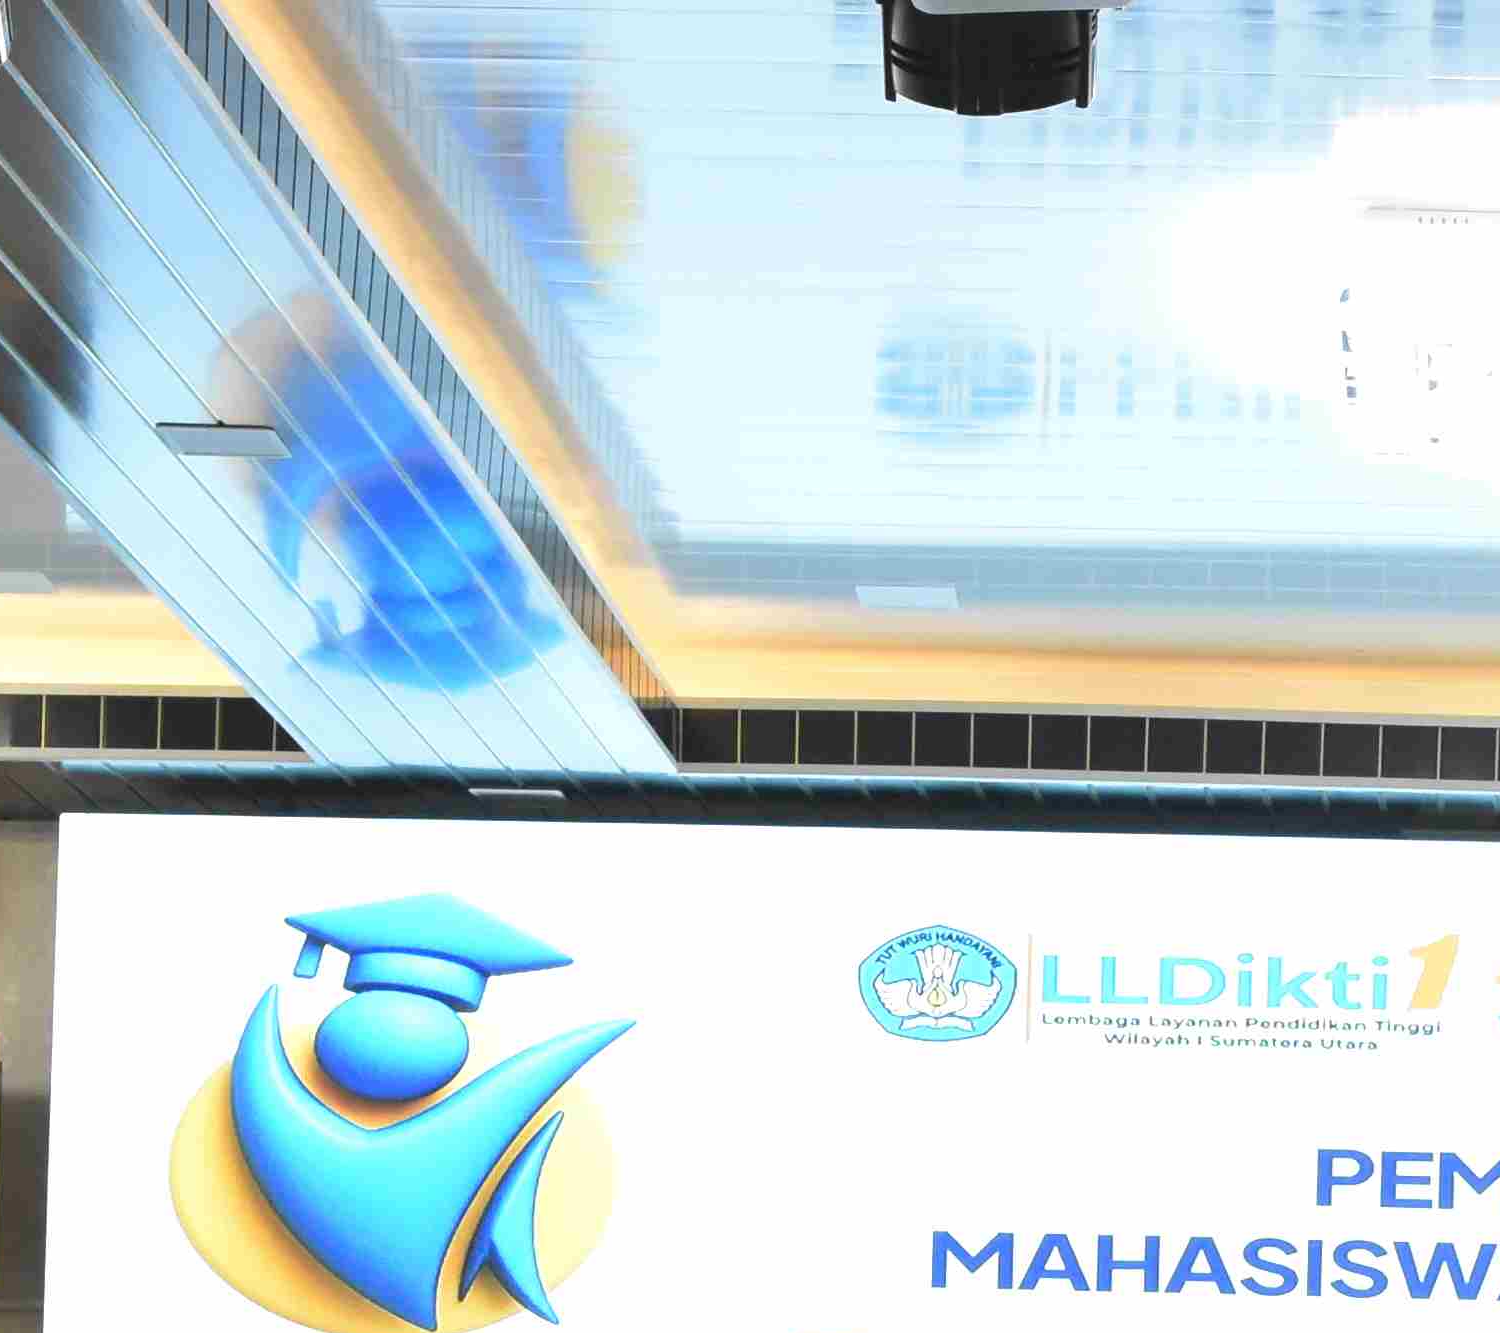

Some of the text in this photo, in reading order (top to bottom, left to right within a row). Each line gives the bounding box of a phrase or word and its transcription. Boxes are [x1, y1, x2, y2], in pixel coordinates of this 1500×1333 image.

[1042, 953, 1389, 1011] LLDikti
[1041, 1013, 1442, 1036] Lembaga Layanan Pendidikan Tinggi
[1104, 1033, 1191, 1048] Wilayah
[1211, 1036, 1314, 1050] Sumatera
[1321, 1039, 1379, 1051] Utara
